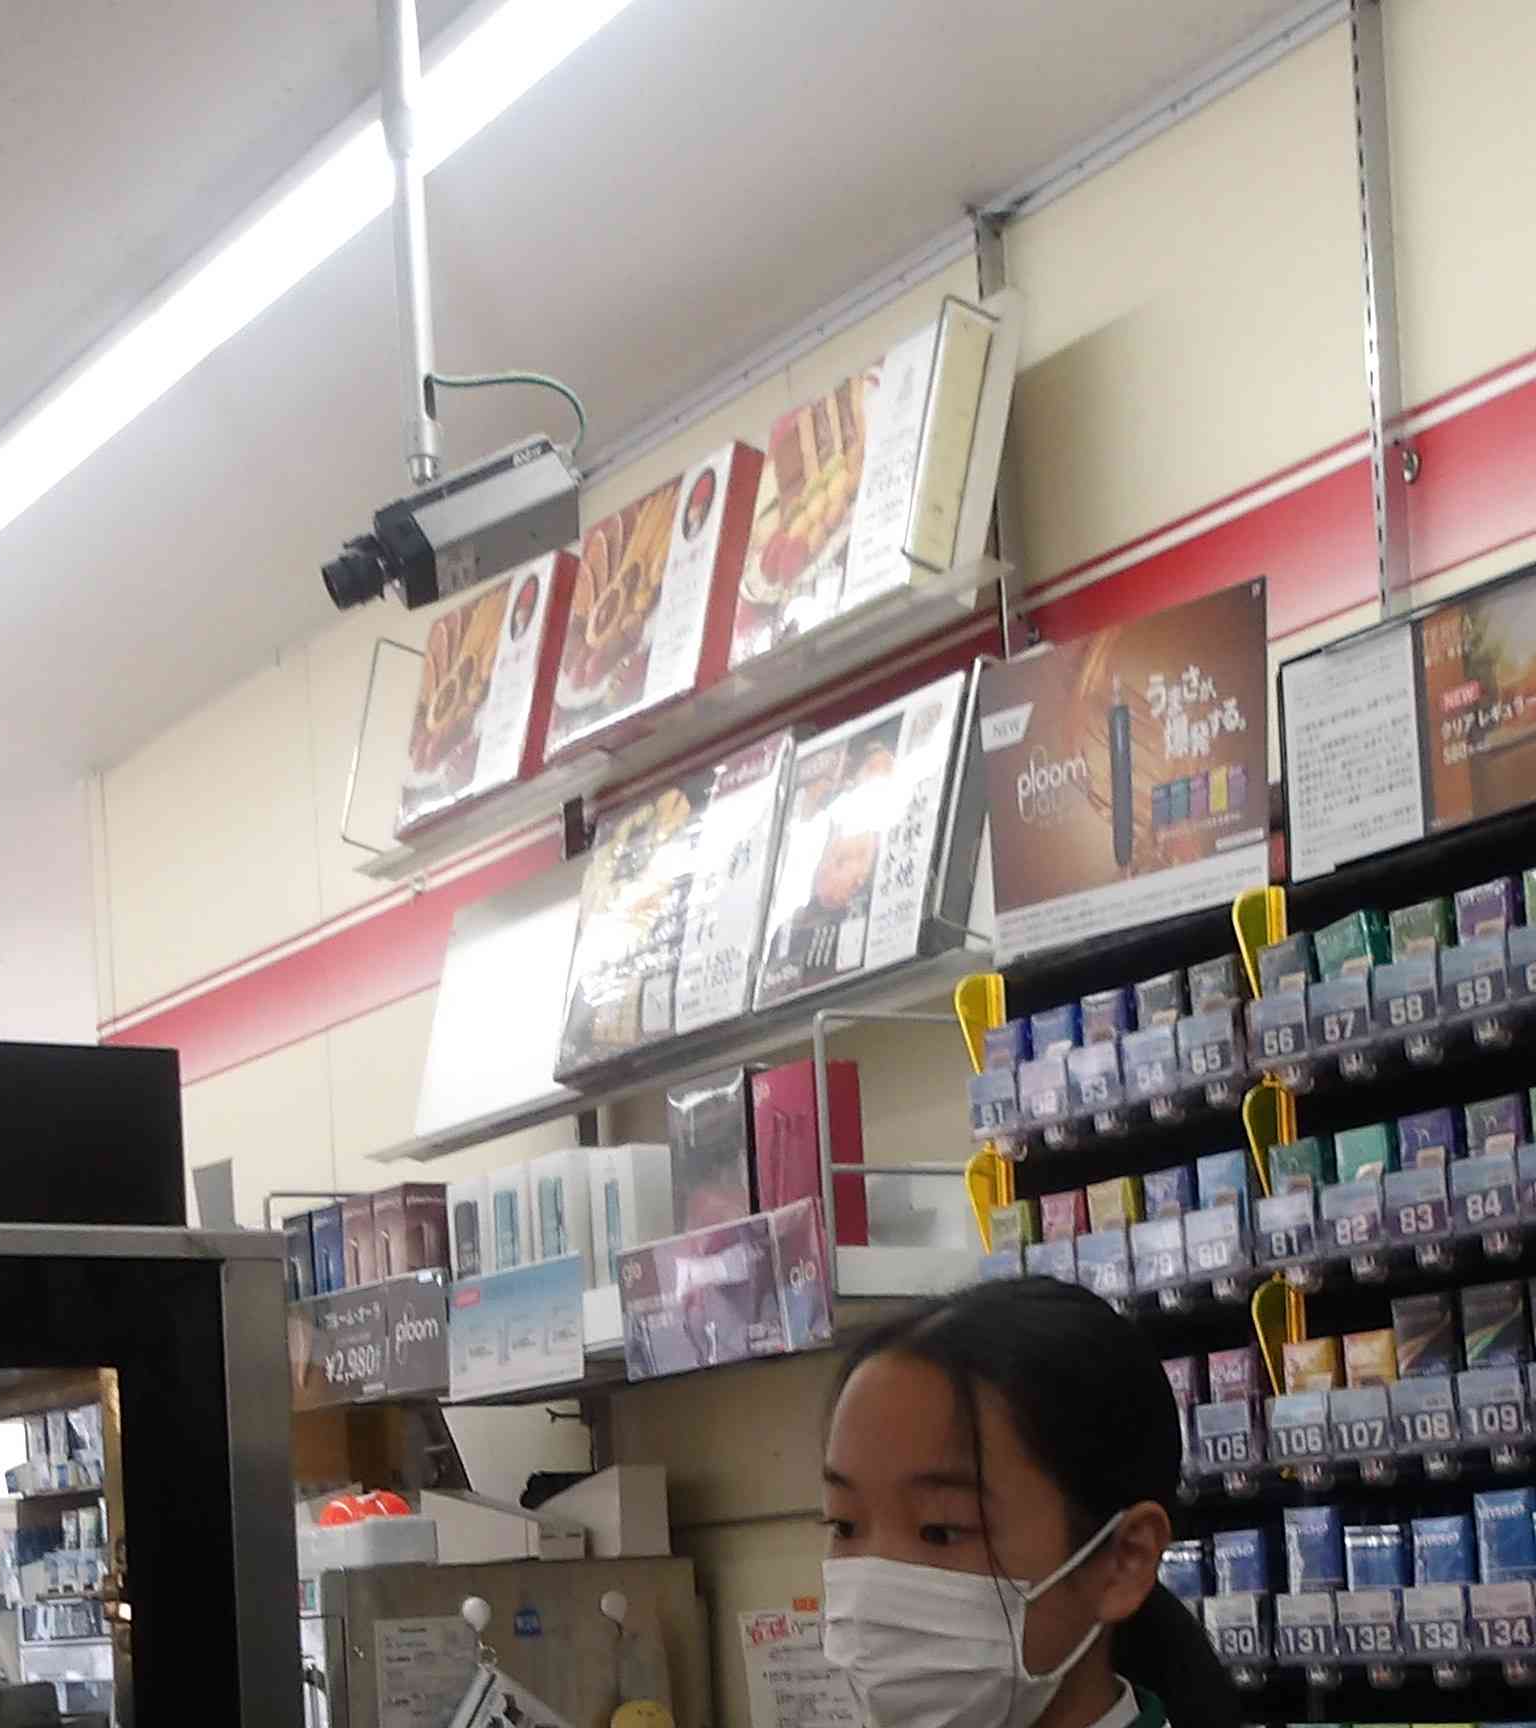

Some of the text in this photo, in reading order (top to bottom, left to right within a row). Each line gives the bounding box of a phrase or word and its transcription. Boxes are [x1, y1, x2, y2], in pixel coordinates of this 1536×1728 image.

[1016, 747, 1088, 806] ploom
[1400, 1411, 1448, 1442] 108
[1479, 1617, 1530, 1648] 134
